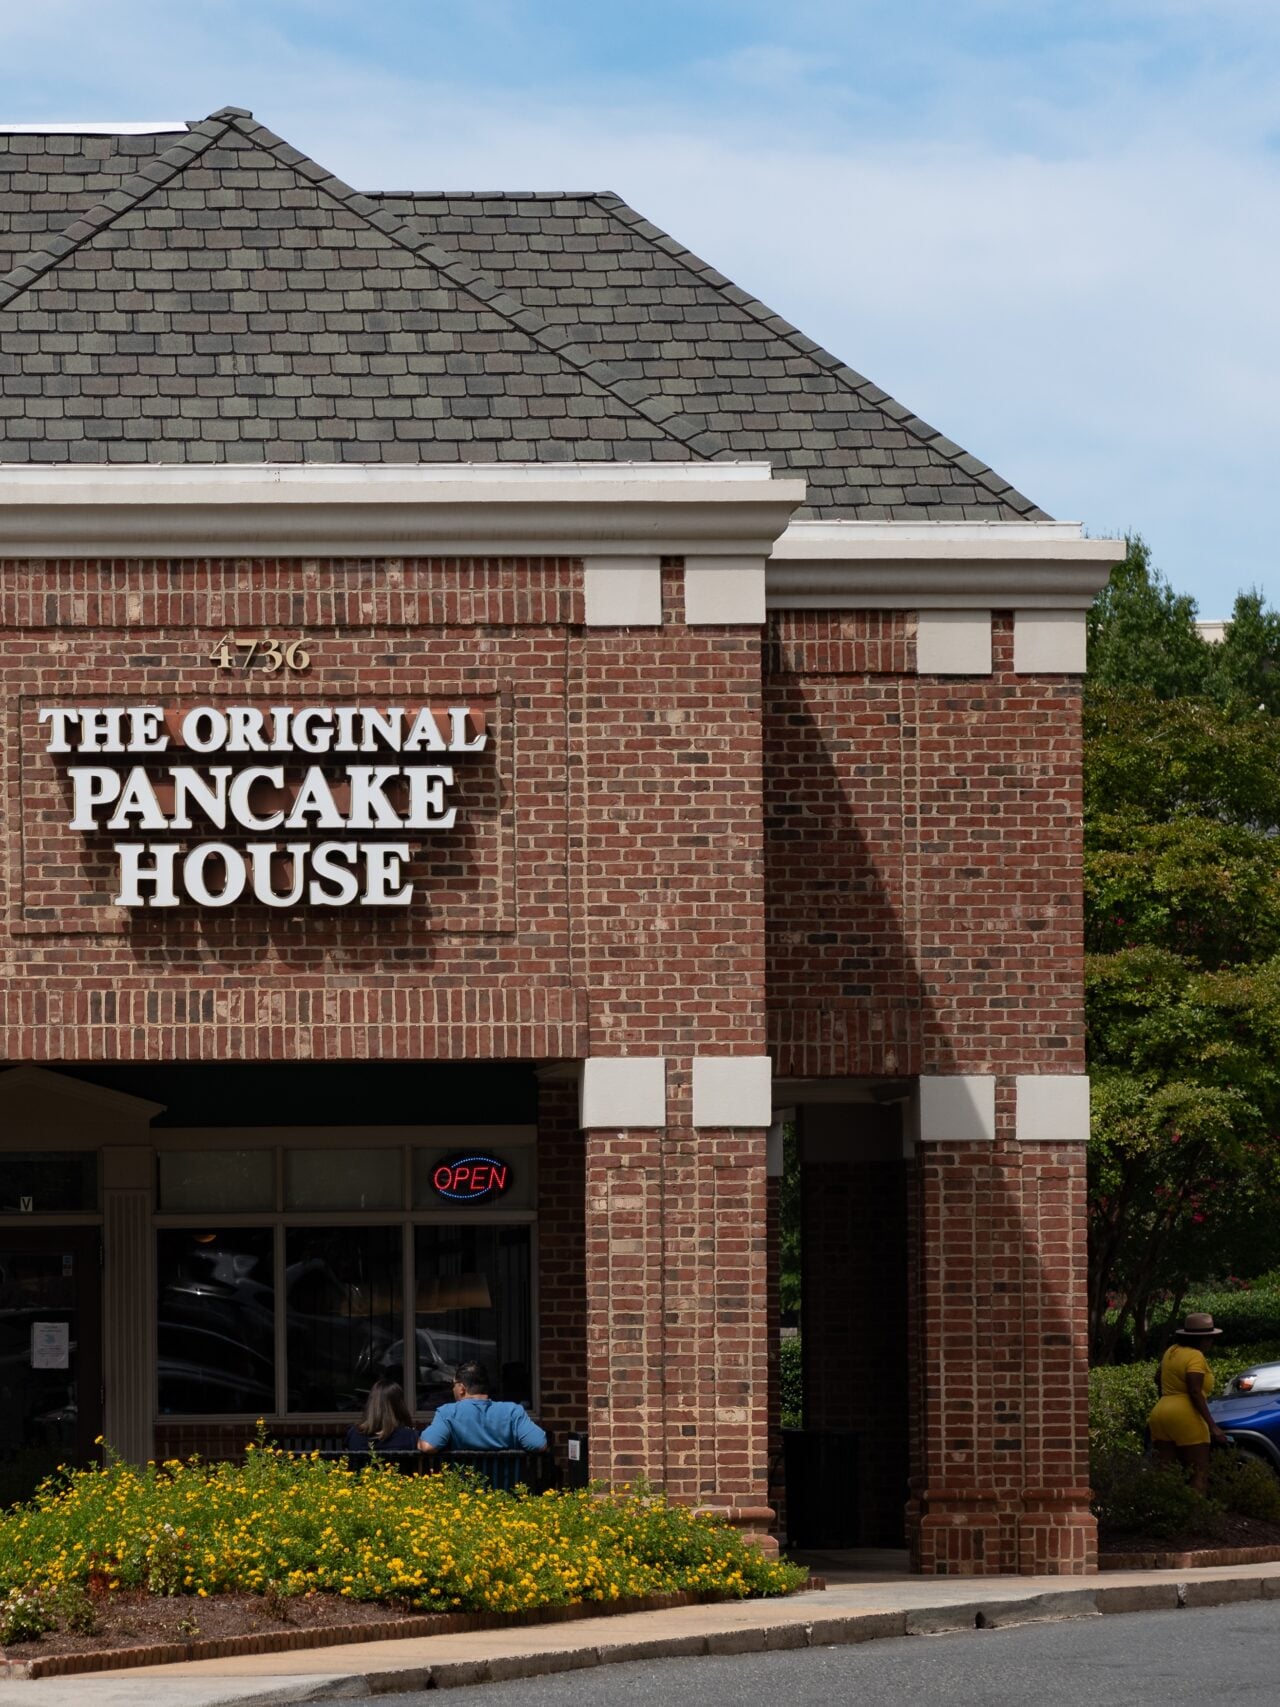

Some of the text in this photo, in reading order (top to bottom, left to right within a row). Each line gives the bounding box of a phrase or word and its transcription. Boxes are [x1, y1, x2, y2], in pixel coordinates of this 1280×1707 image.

[209, 635, 313, 673] 4736
[39, 706, 487, 753] THE ORIGINAL
[67, 765, 458, 831] PANCAKE
[114, 841, 414, 907] HOUSE
[434, 1166, 507, 1190] OPEN
[22, 1197, 32, 1210] V
